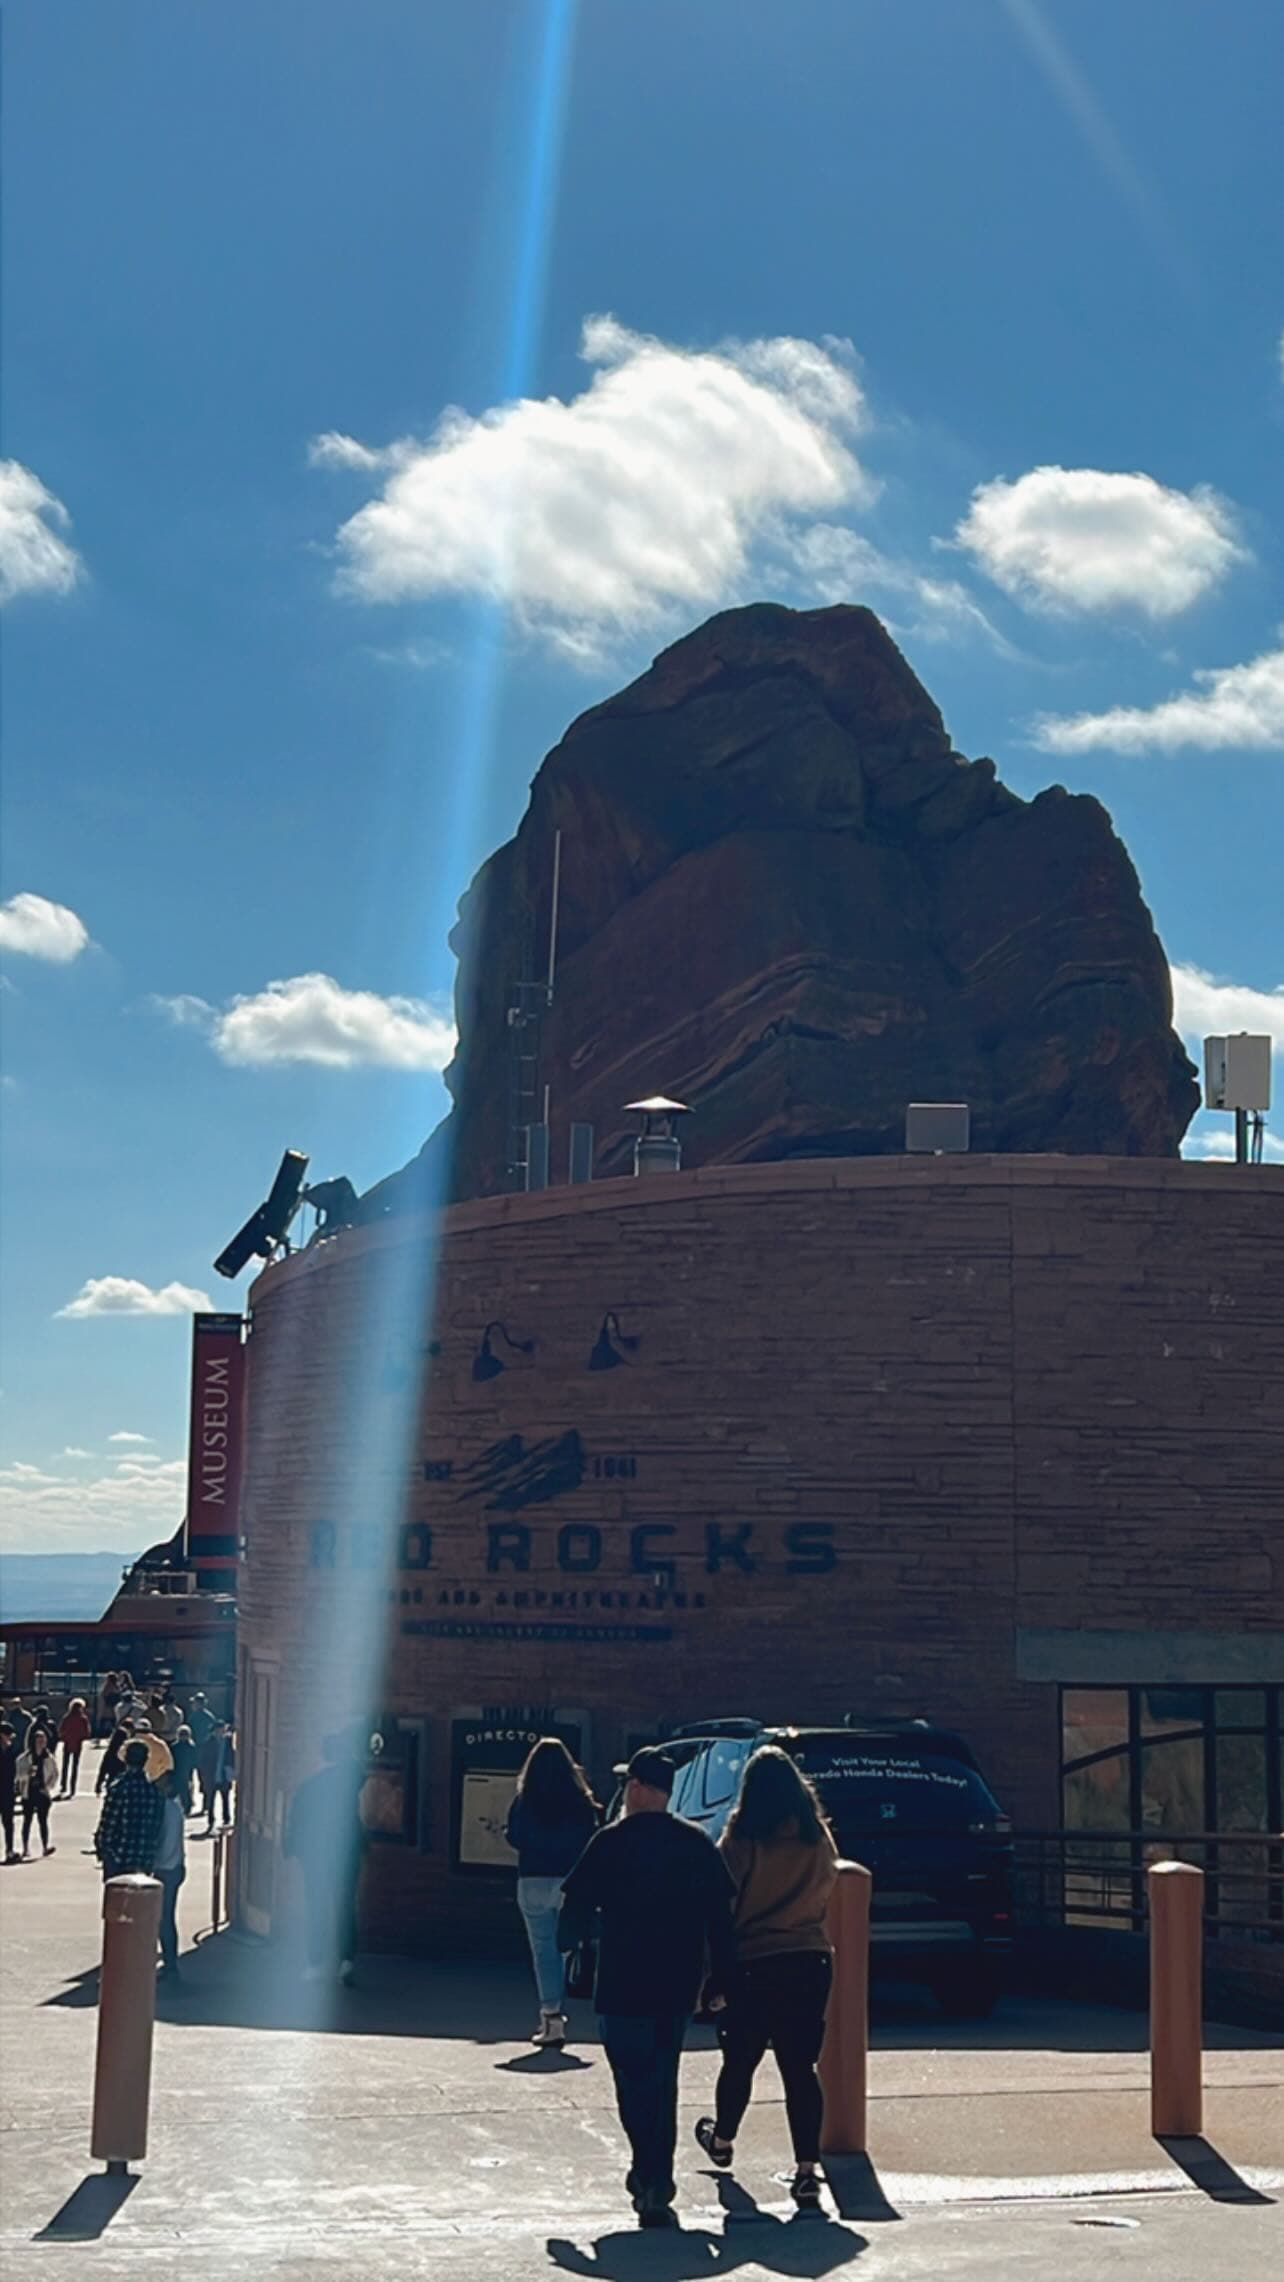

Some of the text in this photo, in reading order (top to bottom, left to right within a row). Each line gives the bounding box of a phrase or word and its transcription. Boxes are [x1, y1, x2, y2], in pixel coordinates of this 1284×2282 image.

[202, 1357, 229, 1504] MUSEUM
[309, 1520, 839, 1575] RD ROCKS
[832, 1756, 920, 1768] Visit Your Local
[843, 1768, 883, 1777] Honda
[886, 1768, 930, 1780] Dealers
[931, 1772, 968, 1787] Today!
